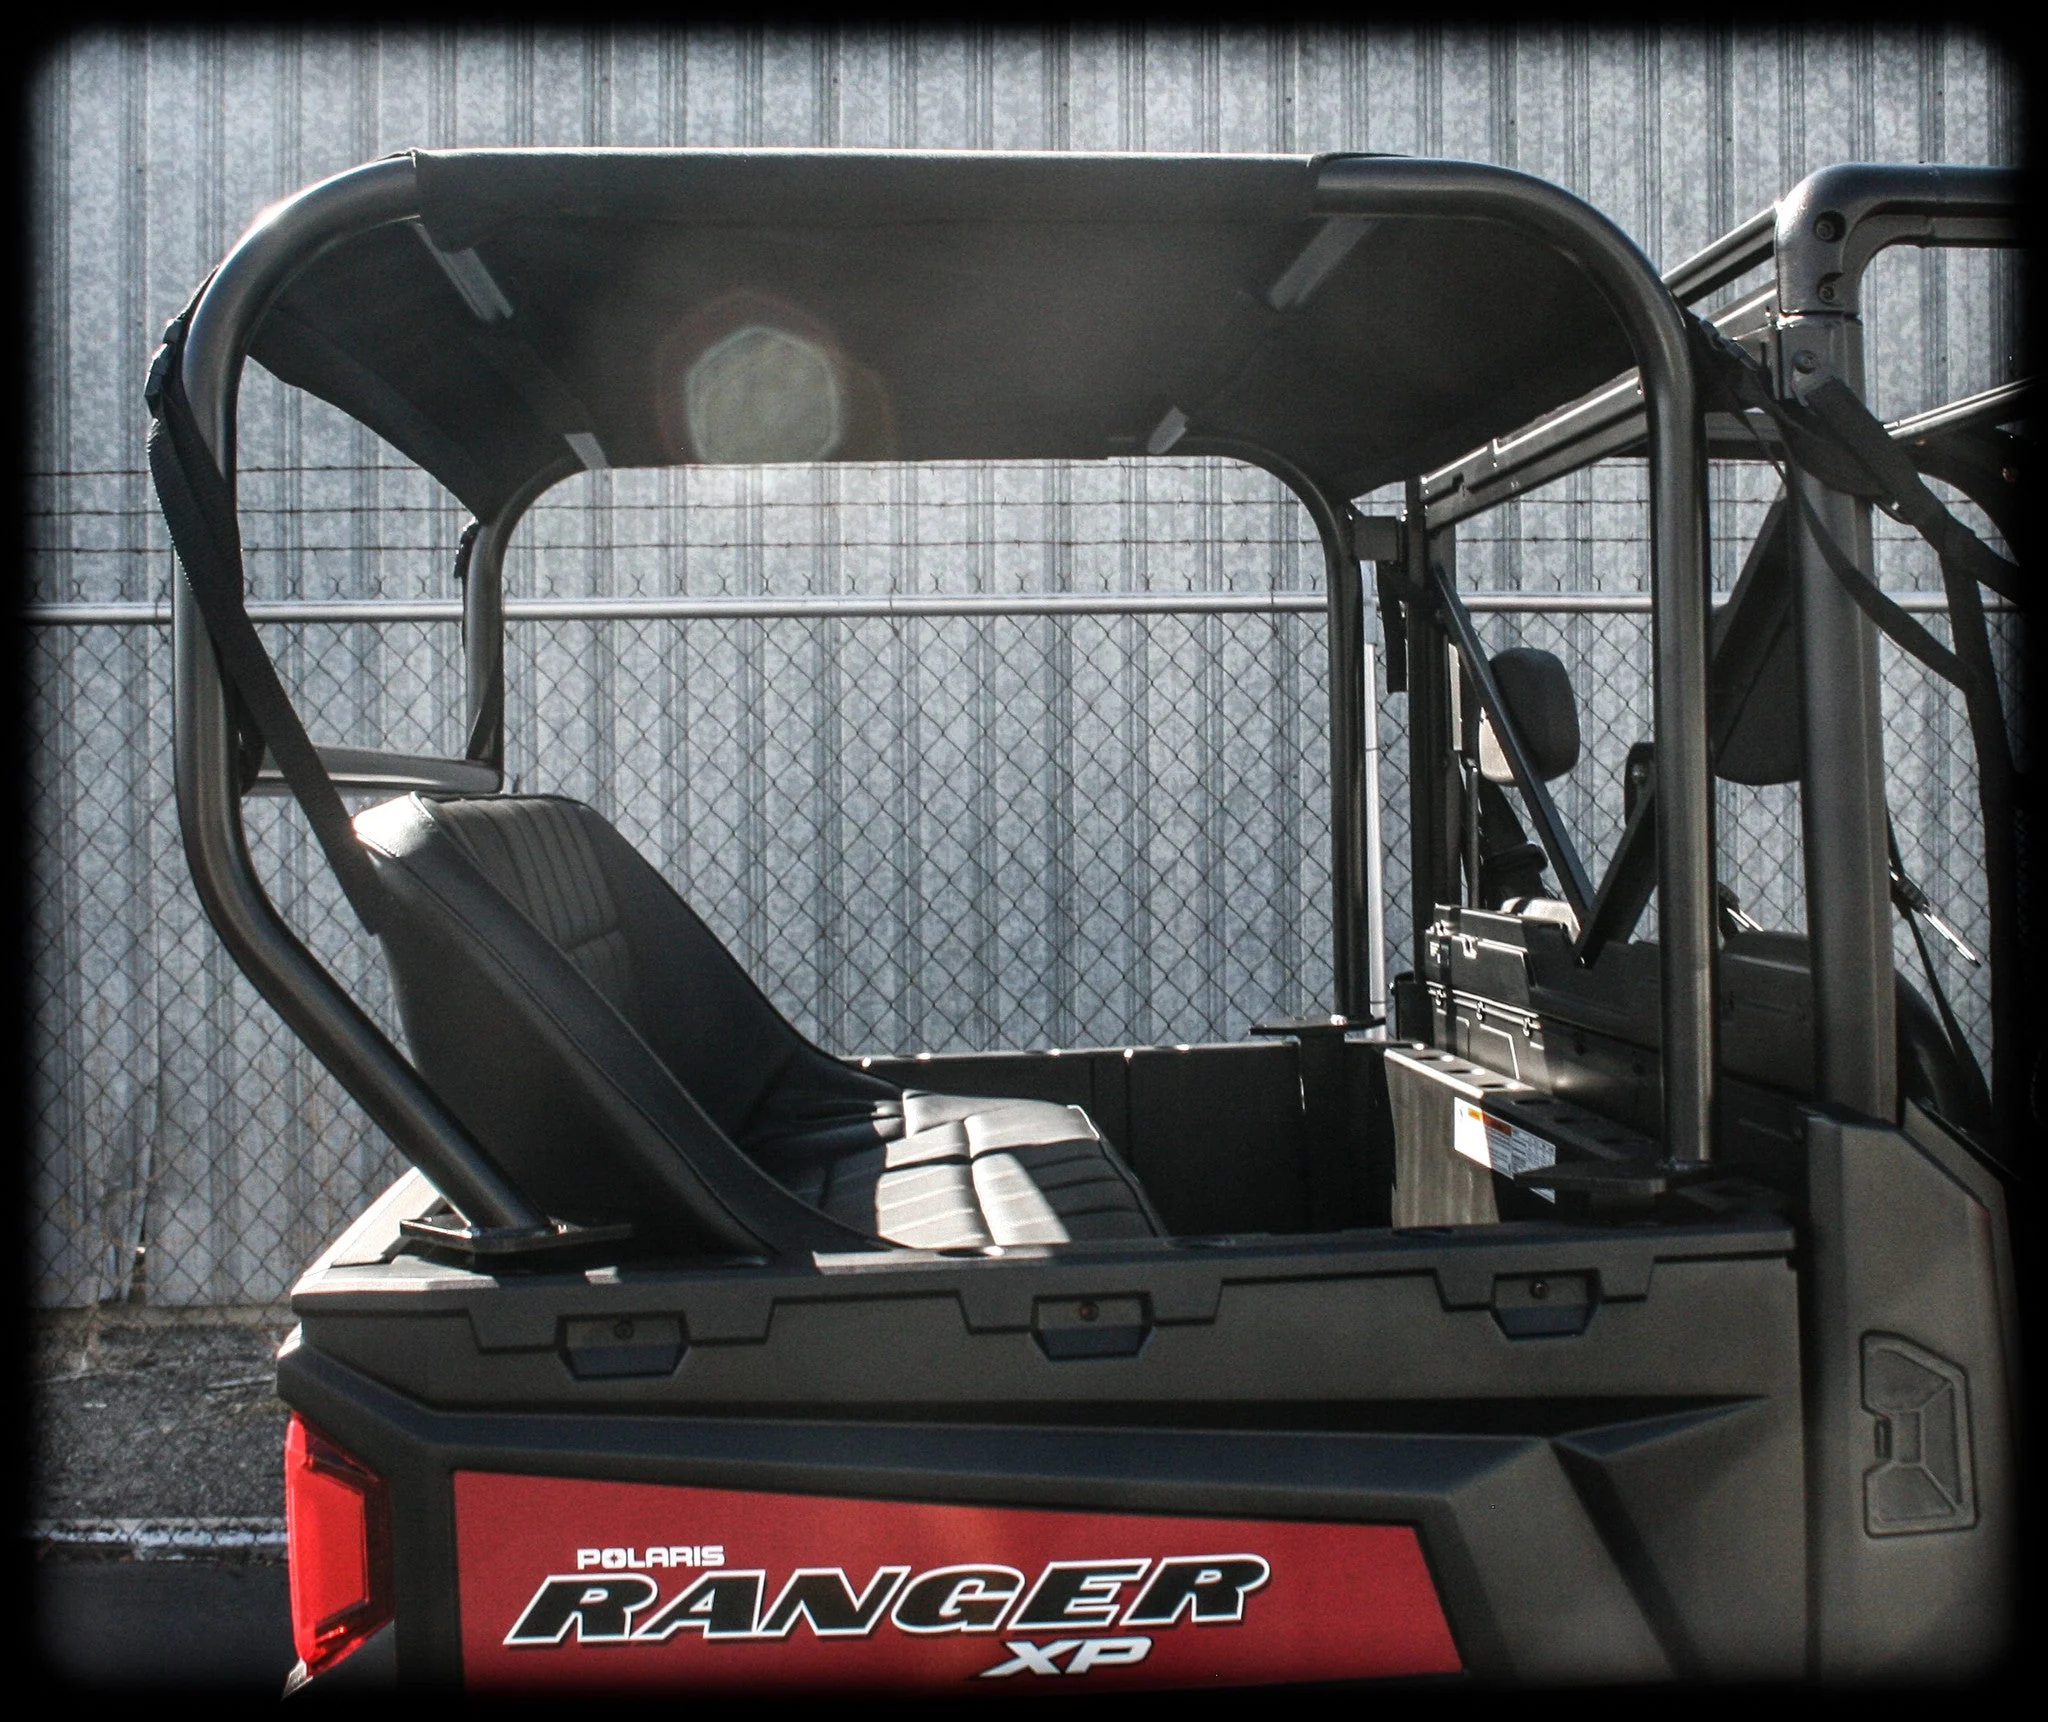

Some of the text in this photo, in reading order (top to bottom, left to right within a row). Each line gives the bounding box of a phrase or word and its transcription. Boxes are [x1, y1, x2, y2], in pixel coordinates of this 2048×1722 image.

[577, 1545, 726, 1570] POLARIS
[503, 1553, 1271, 1645] RANGER
[978, 1636, 1153, 1676] XP
